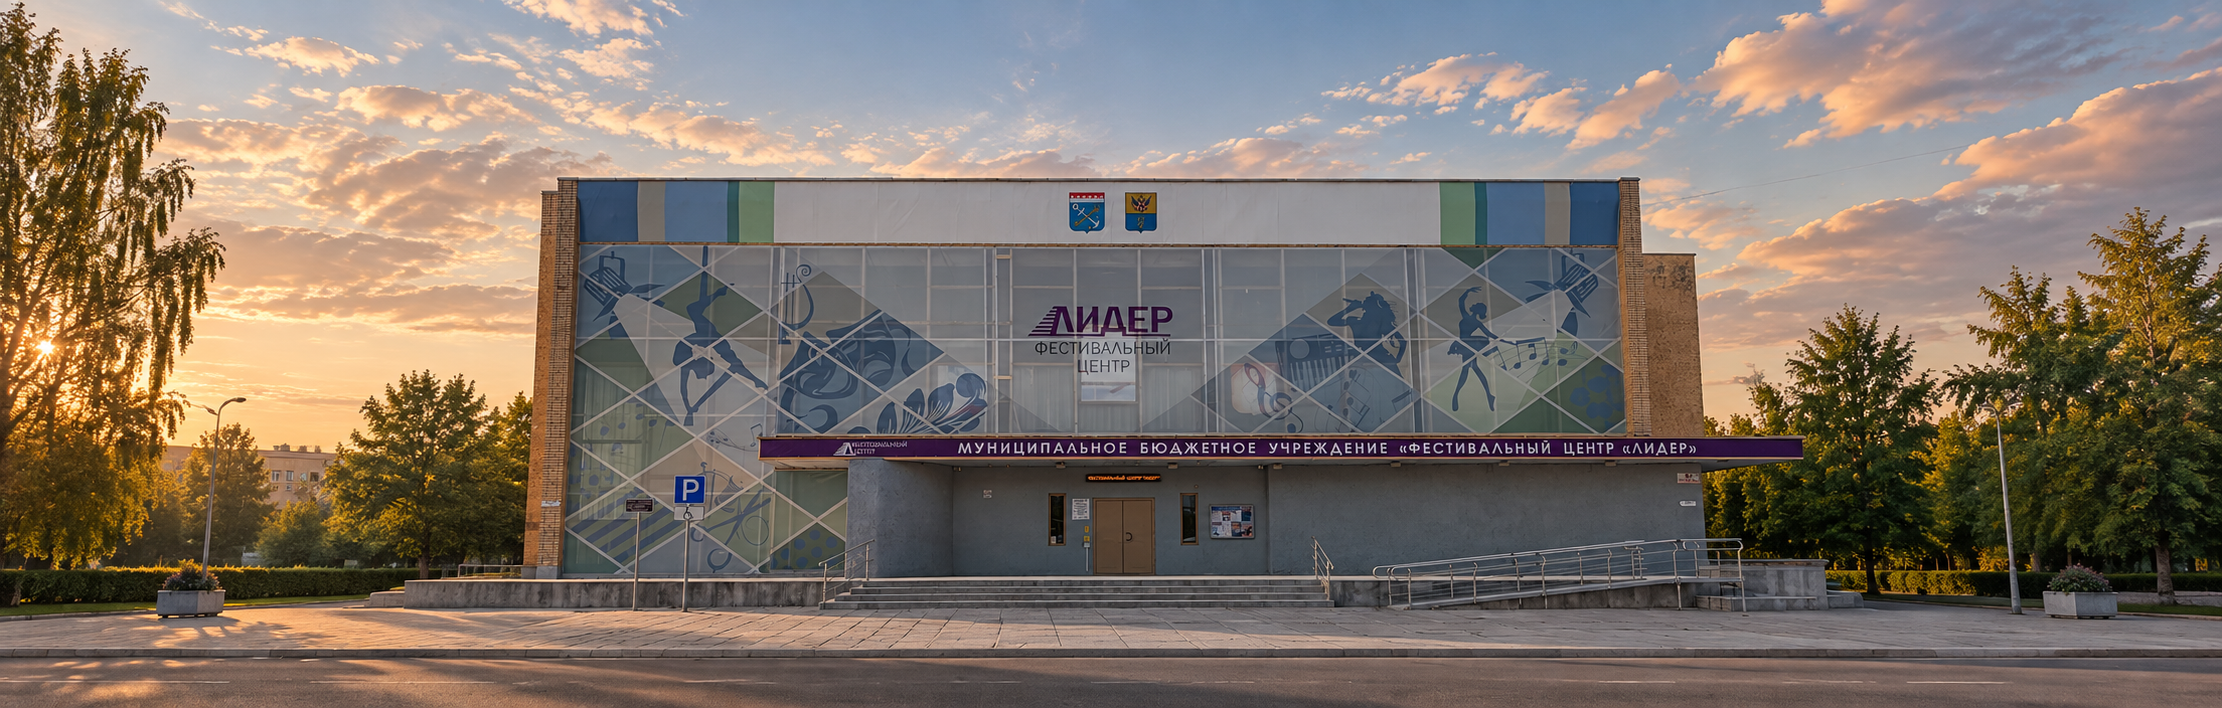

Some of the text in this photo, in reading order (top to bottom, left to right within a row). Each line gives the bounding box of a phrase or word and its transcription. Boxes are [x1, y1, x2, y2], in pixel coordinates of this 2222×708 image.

[1028, 305, 1173, 337] ЛИДЕР
[1034, 338, 1171, 356] ФЕСТИВАЛЬНЫЙ
[1077, 359, 1130, 375] ЦЕНТР
[957, 440, 1697, 456] МУНИЦИПАЛЬНОЕ БЮДЖЕТНОЕ УЧРЕЖДЕНИЕ «ФЕСТИВАЛЬНЫЙ ЦЕНТР «ЛИДЕР»
[682, 479, 699, 501] P
